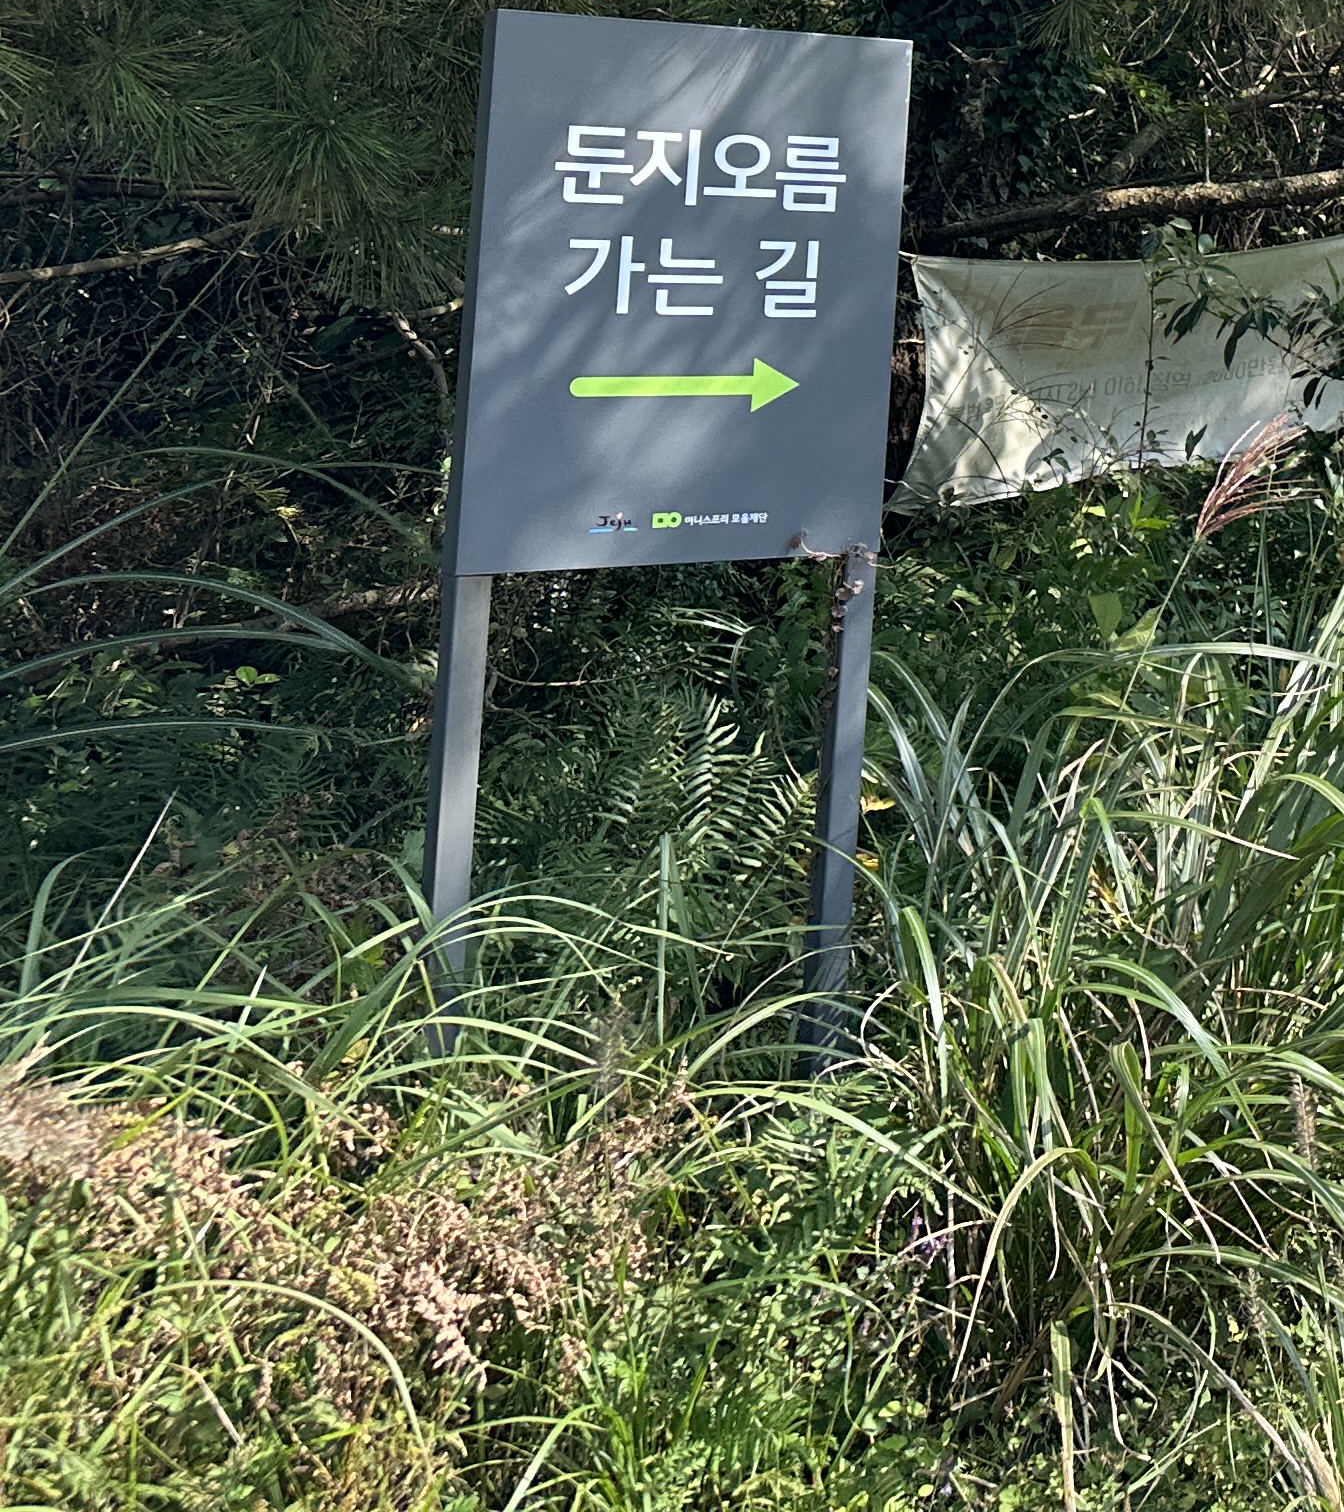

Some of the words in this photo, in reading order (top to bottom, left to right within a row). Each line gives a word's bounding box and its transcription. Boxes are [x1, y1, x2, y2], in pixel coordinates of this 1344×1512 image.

[554, 124, 847, 213] 둔지오름
[564, 235, 724, 316] 가는
[755, 239, 821, 319] 길
[596, 512, 633, 532] Jeju
